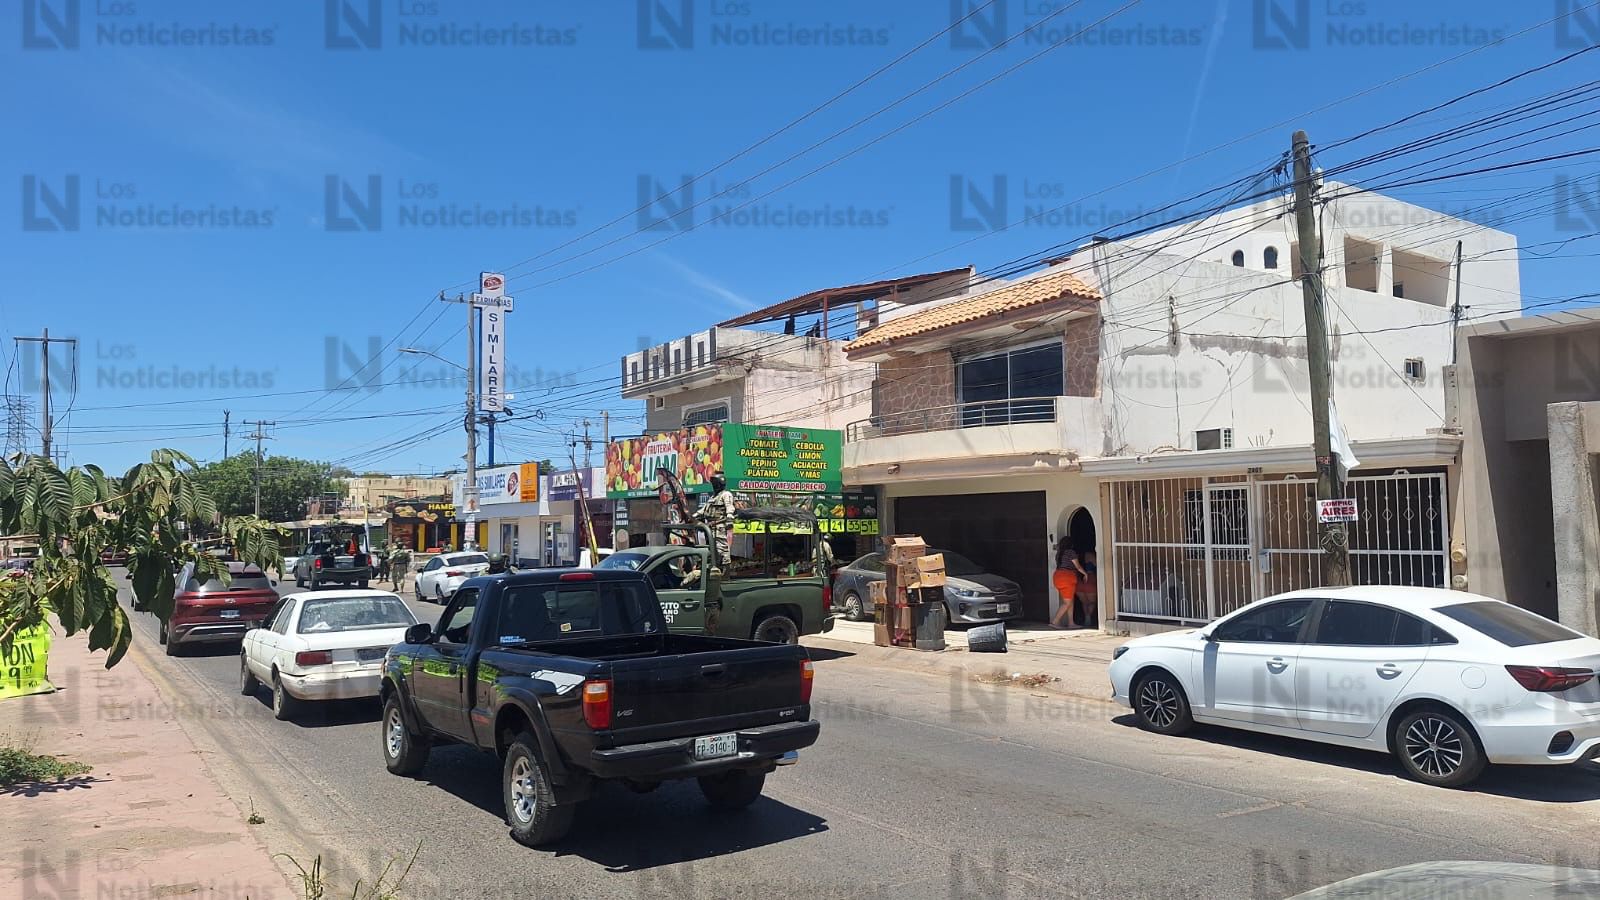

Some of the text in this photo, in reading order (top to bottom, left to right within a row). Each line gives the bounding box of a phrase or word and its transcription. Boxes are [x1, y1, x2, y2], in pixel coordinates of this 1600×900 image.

[487, 313, 499, 406] SIMILARES
[749, 440, 779, 449] TOMATE
[795, 442, 825, 451] CEBOLLA
[740, 449, 788, 459] PAPA BLANCA
[751, 459, 777, 468] PEPINO
[792, 461, 828, 470] AGUACATE
[739, 480, 769, 490] CALIDAD
[776, 481, 801, 491] MEJOR
[801, 482, 826, 491] PRECIO
[1321, 507, 1356, 516] AIRES
